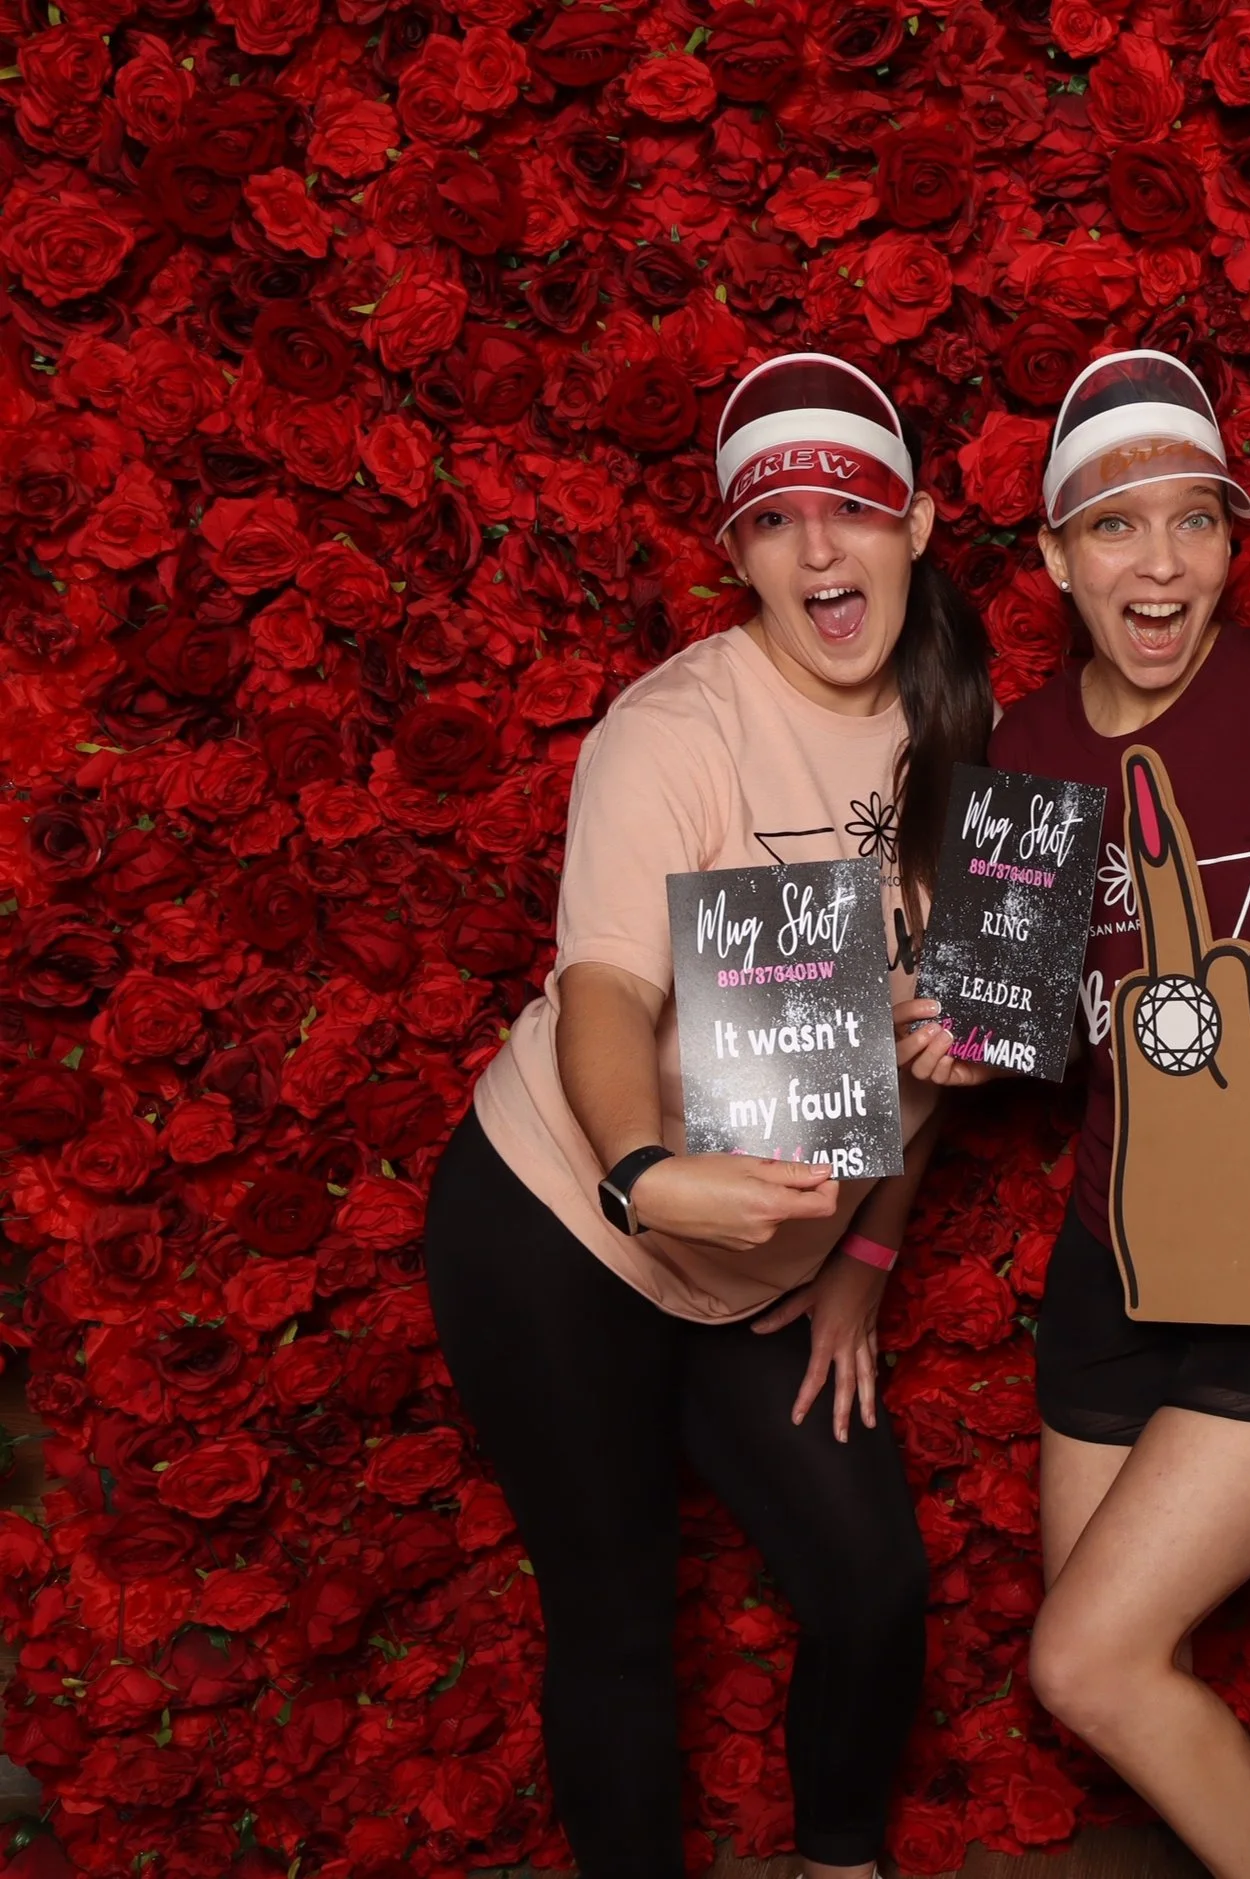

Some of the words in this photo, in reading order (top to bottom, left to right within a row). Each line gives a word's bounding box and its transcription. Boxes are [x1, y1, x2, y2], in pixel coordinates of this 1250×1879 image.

[733, 449, 860, 502] CREW
[962, 786, 1014, 862] Mug
[1019, 794, 1083, 868] Shot
[697, 889, 763, 974] Mug
[778, 882, 857, 954] Shot
[980, 910, 1029, 942] RING
[1089, 923, 1114, 937] SAN
[960, 975, 1032, 1012] LEADER
[714, 1019, 739, 1061] It
[747, 1008, 861, 1056] wasn't
[730, 1100, 777, 1141] my
[787, 1073, 868, 1121] fault
